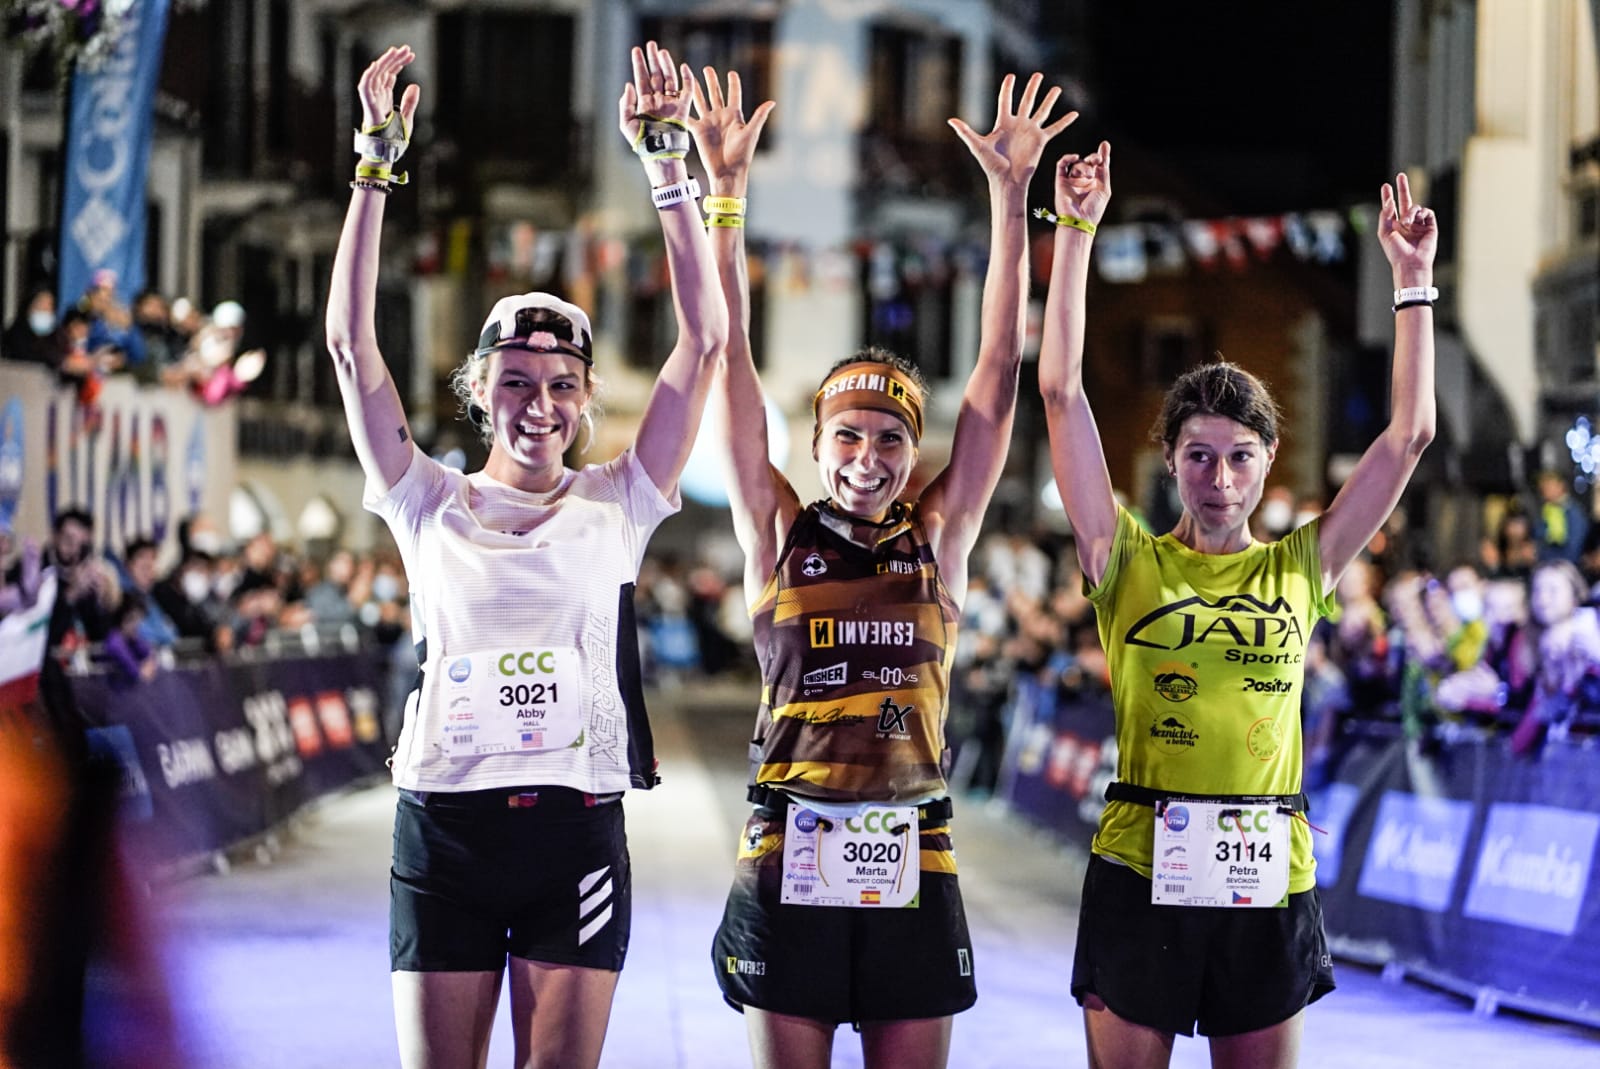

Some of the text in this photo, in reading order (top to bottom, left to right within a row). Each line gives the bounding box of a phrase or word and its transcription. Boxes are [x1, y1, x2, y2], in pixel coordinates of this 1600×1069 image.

[838, 620, 914, 647] INVERSE
[1174, 611, 1303, 651] JAPA
[498, 651, 555, 676] CCC
[499, 683, 558, 707] 3021
[588, 611, 620, 766] TERREX
[516, 708, 546, 719] Abby
[845, 811, 897, 834] CCC
[1217, 809, 1269, 833] CCC
[843, 842, 901, 863] 3020
[1215, 841, 1272, 862] 3114
[856, 866, 888, 876] Marta
[1229, 865, 1258, 876] Petra
